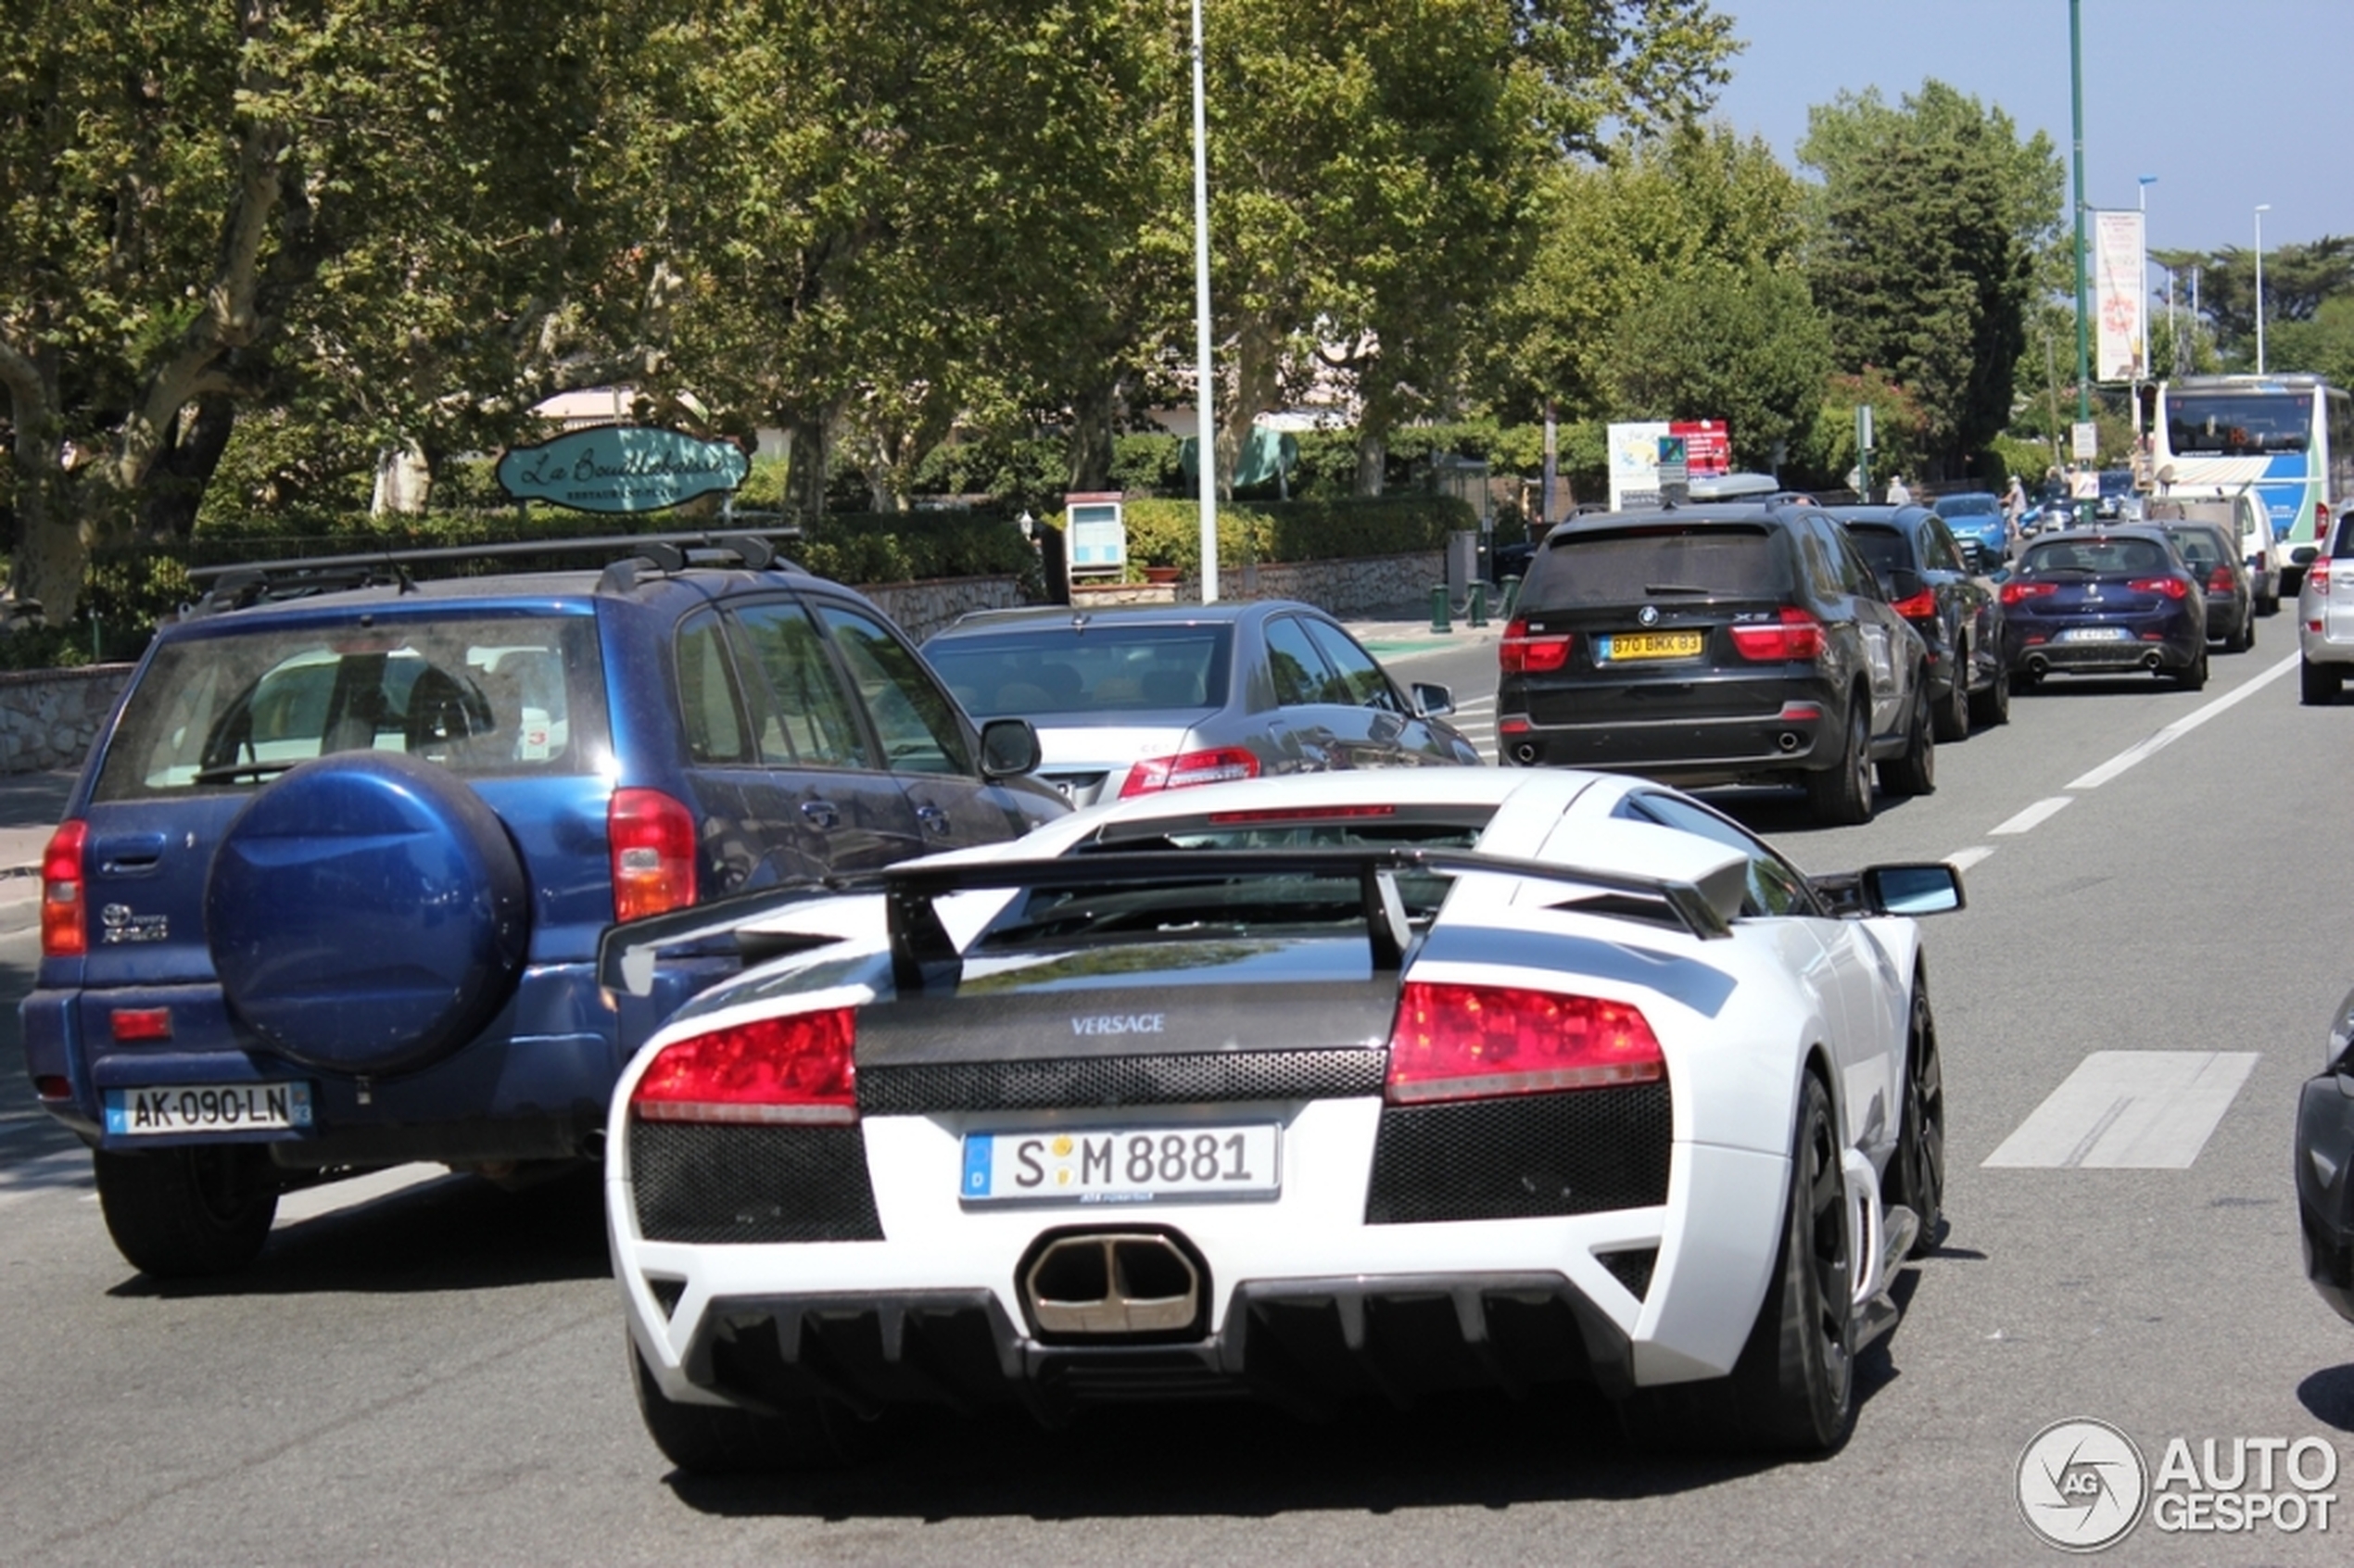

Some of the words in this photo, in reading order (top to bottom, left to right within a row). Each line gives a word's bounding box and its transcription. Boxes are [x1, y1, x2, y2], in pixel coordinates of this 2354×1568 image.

[521, 452, 565, 485] La
[1614, 638, 1640, 653] 870
[1678, 634, 1699, 649] 83
[1071, 1014, 1164, 1035] VERSACE
[134, 1087, 289, 1127] AK-090-LN
[972, 1172, 983, 1187] D
